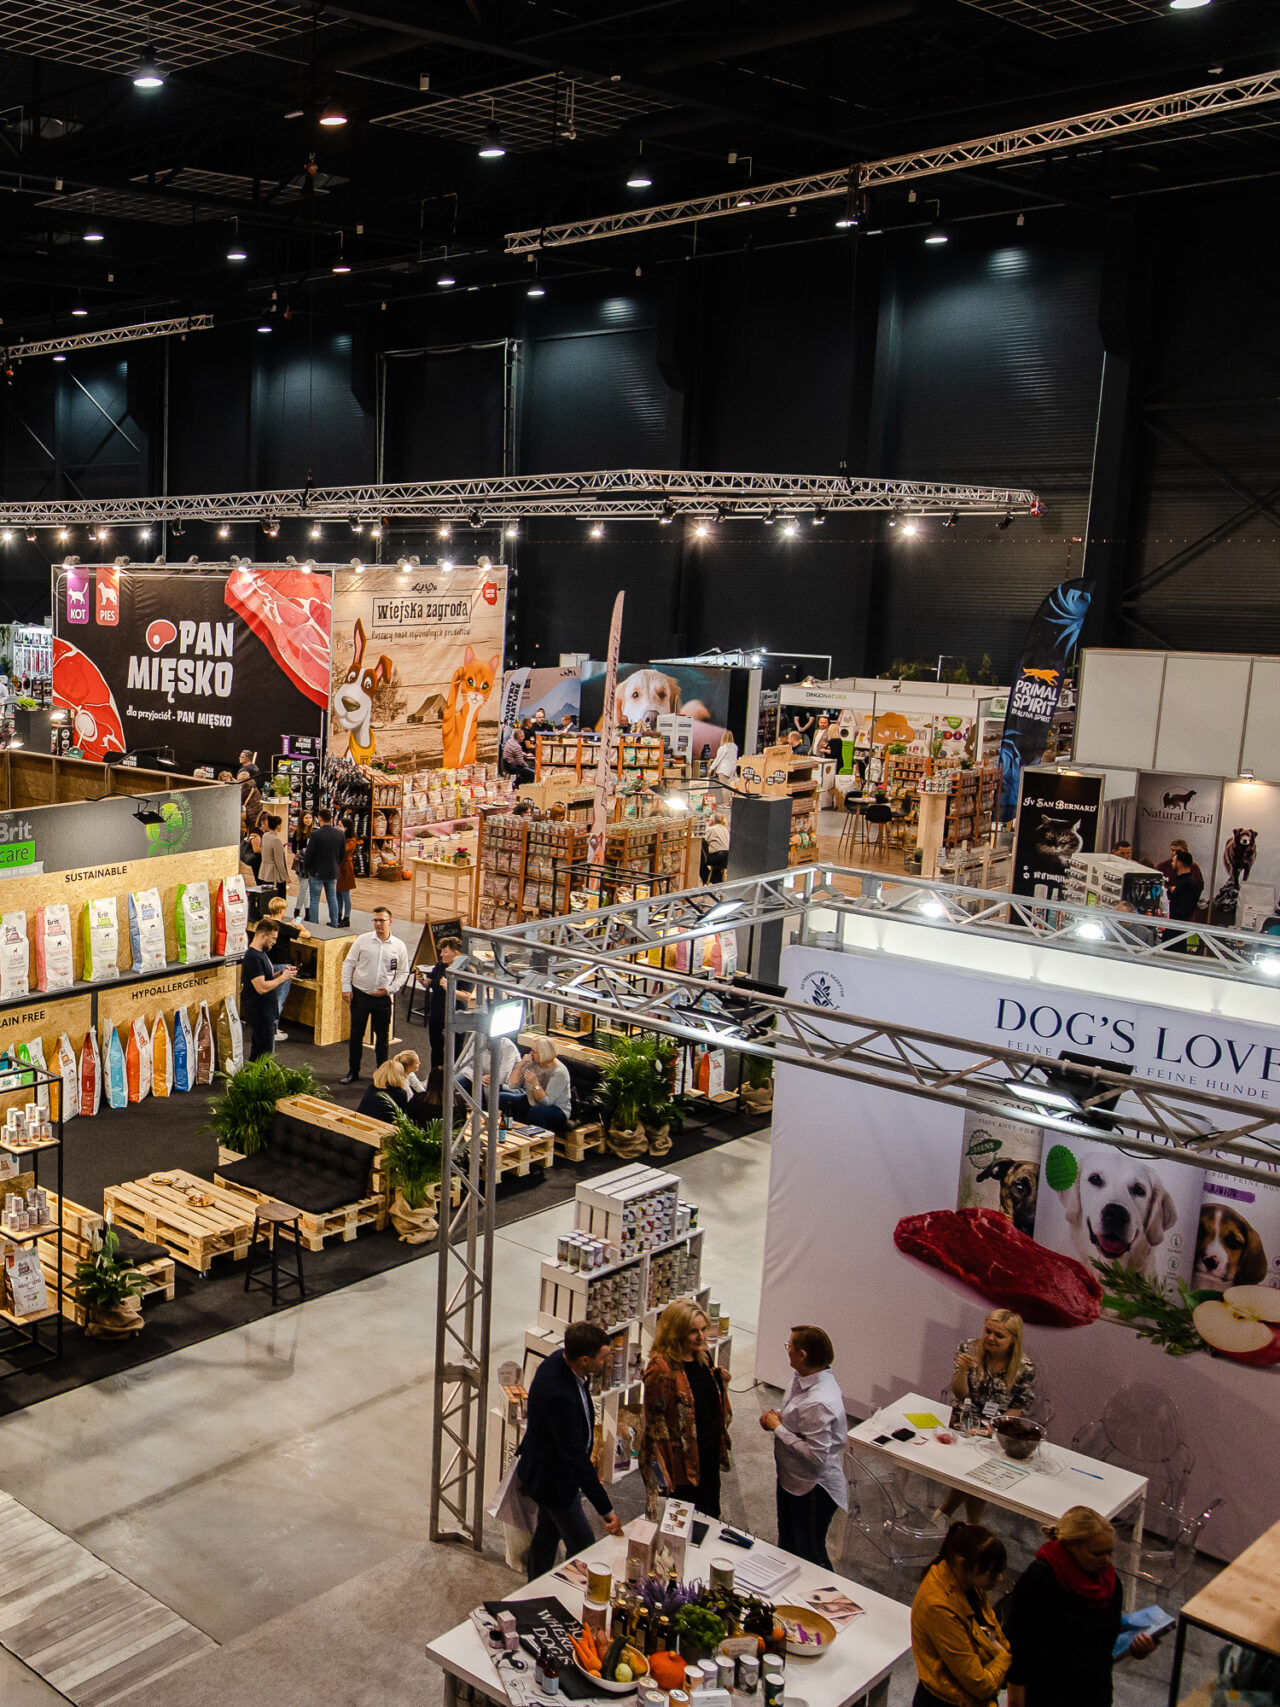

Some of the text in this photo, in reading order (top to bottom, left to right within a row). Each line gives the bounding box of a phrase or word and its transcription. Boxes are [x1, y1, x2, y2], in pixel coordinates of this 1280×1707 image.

[70, 608, 86, 620] KOT
[100, 609, 115, 621] PIES
[426, 600, 468, 622] zagroda
[179, 620, 234, 657] PAN
[127, 655, 233, 703] MIĘSKO
[1015, 680, 1057, 701] PRIMAL
[1013, 693, 1056, 716] SPIRIT
[126, 705, 137, 717] dla
[138, 709, 171, 721] przyjaciół
[177, 710, 194, 723] PAN
[197, 713, 232, 729] MIĘSKO
[1142, 807, 1184, 821] Natural
[1186, 811, 1213, 825] Trail
[65, 865, 128, 883] SUSTAINABLE
[131, 976, 209, 1000] HYPOALLERGENIC
[22, 1010, 45, 1023] FREE
[994, 998, 1280, 1083] DOG'S LOVE
[1007, 1040, 1052, 1057] FEINE
[1147, 1066, 1197, 1085] FEINE
[1206, 1079, 1269, 1099] HUNDE
